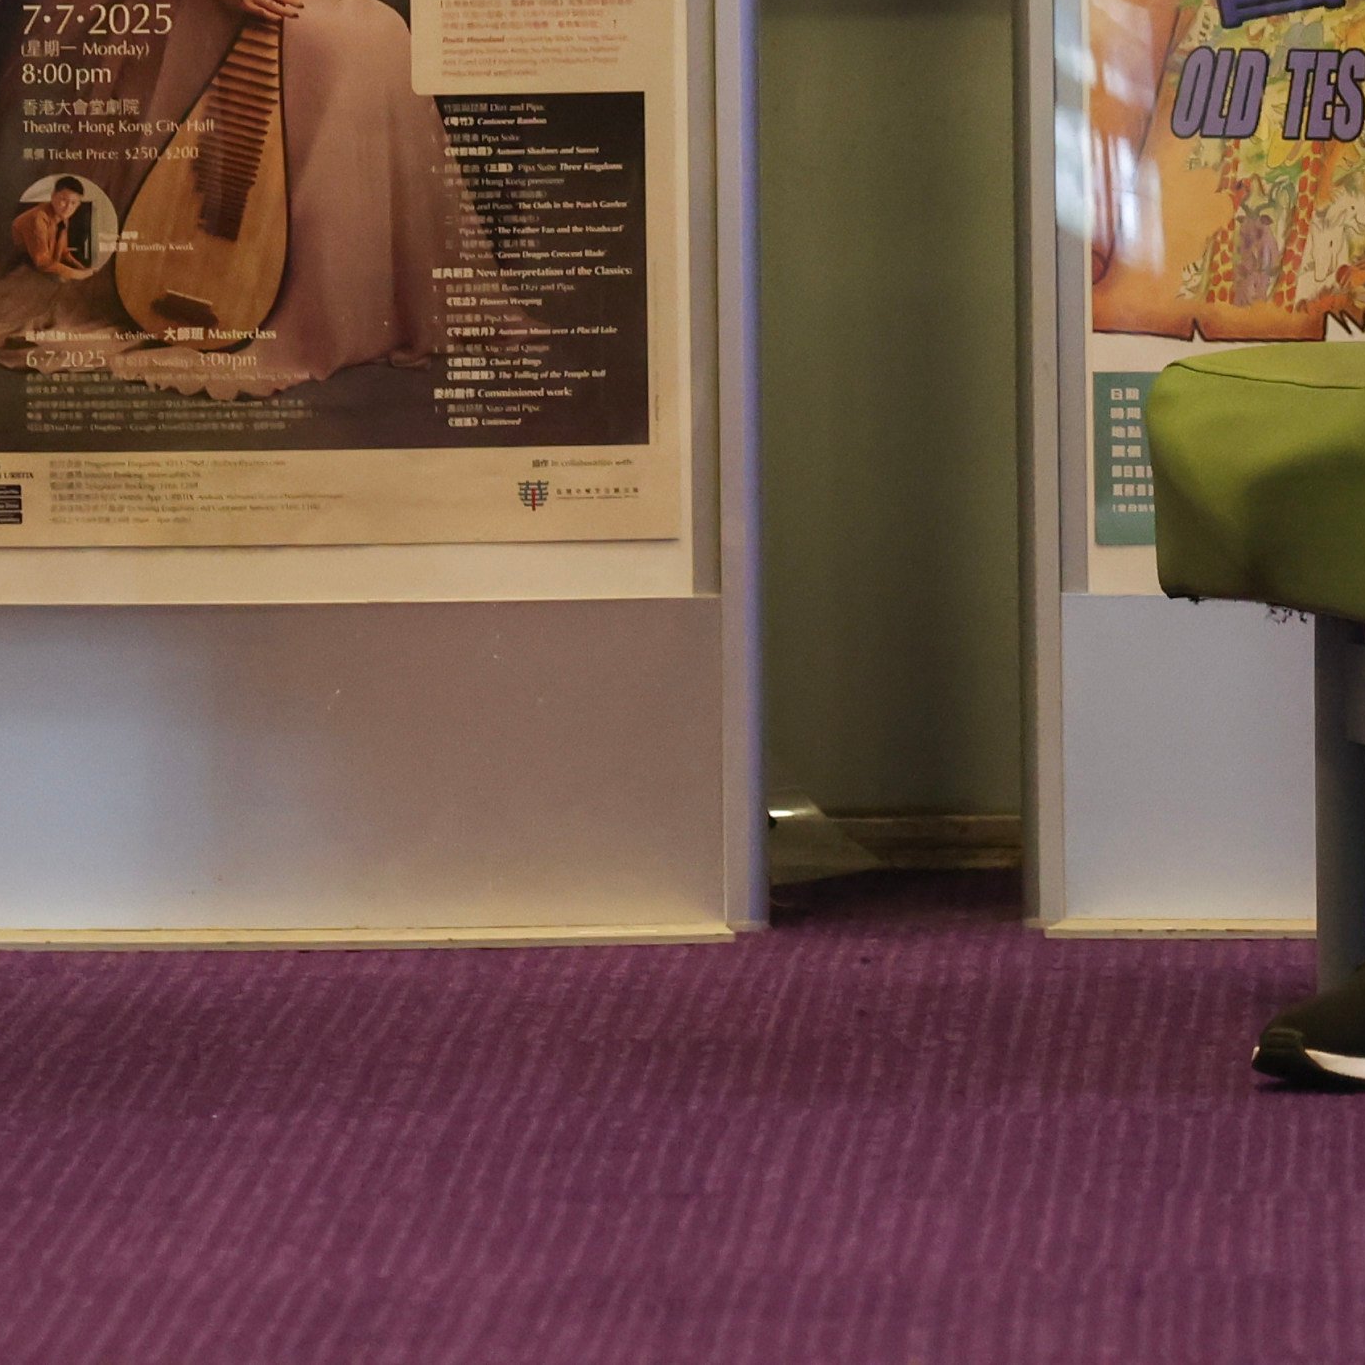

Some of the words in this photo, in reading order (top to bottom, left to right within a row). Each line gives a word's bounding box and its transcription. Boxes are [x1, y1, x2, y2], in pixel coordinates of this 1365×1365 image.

[82, 40, 150, 60] Monday)
[1171, 46, 1269, 141] OLD
[22, 99, 140, 116] 香港大會堂劇院
[23, 120, 73, 134] Theatre,
[78, 120, 115, 136] Hong
[118, 119, 152, 136] Kong
[156, 119, 181, 135] City
[187, 117, 215, 132] Hall
[48, 148, 83, 161] Ticket
[86, 147, 119, 160] Price:
[208, 327, 277, 340] Masterclass
